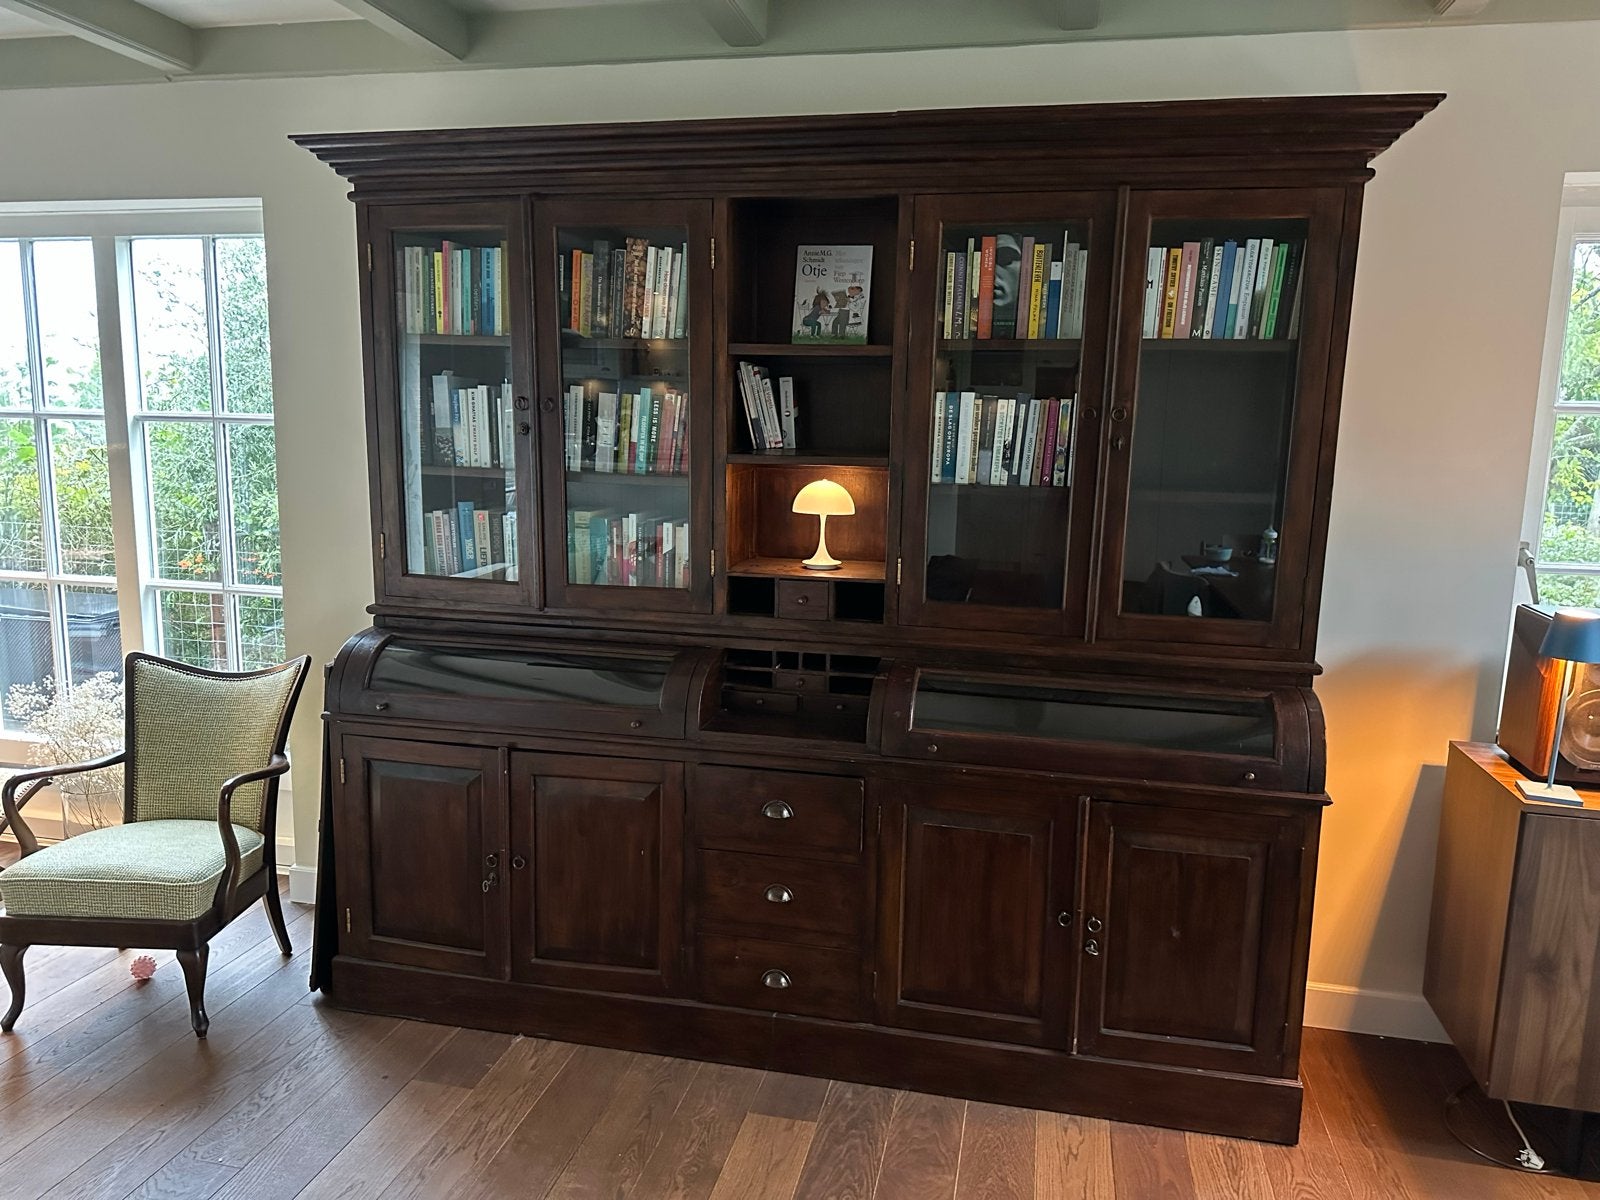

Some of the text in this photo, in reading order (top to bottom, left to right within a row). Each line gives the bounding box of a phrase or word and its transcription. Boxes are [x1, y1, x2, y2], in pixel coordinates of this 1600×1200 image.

[802, 264, 827, 278] Otje
[1034, 250, 1044, 283] BUITENLEVEN
[1245, 258, 1254, 290] TOKARCZUK
[947, 431, 952, 440] OM
[465, 538, 474, 560] VADER
